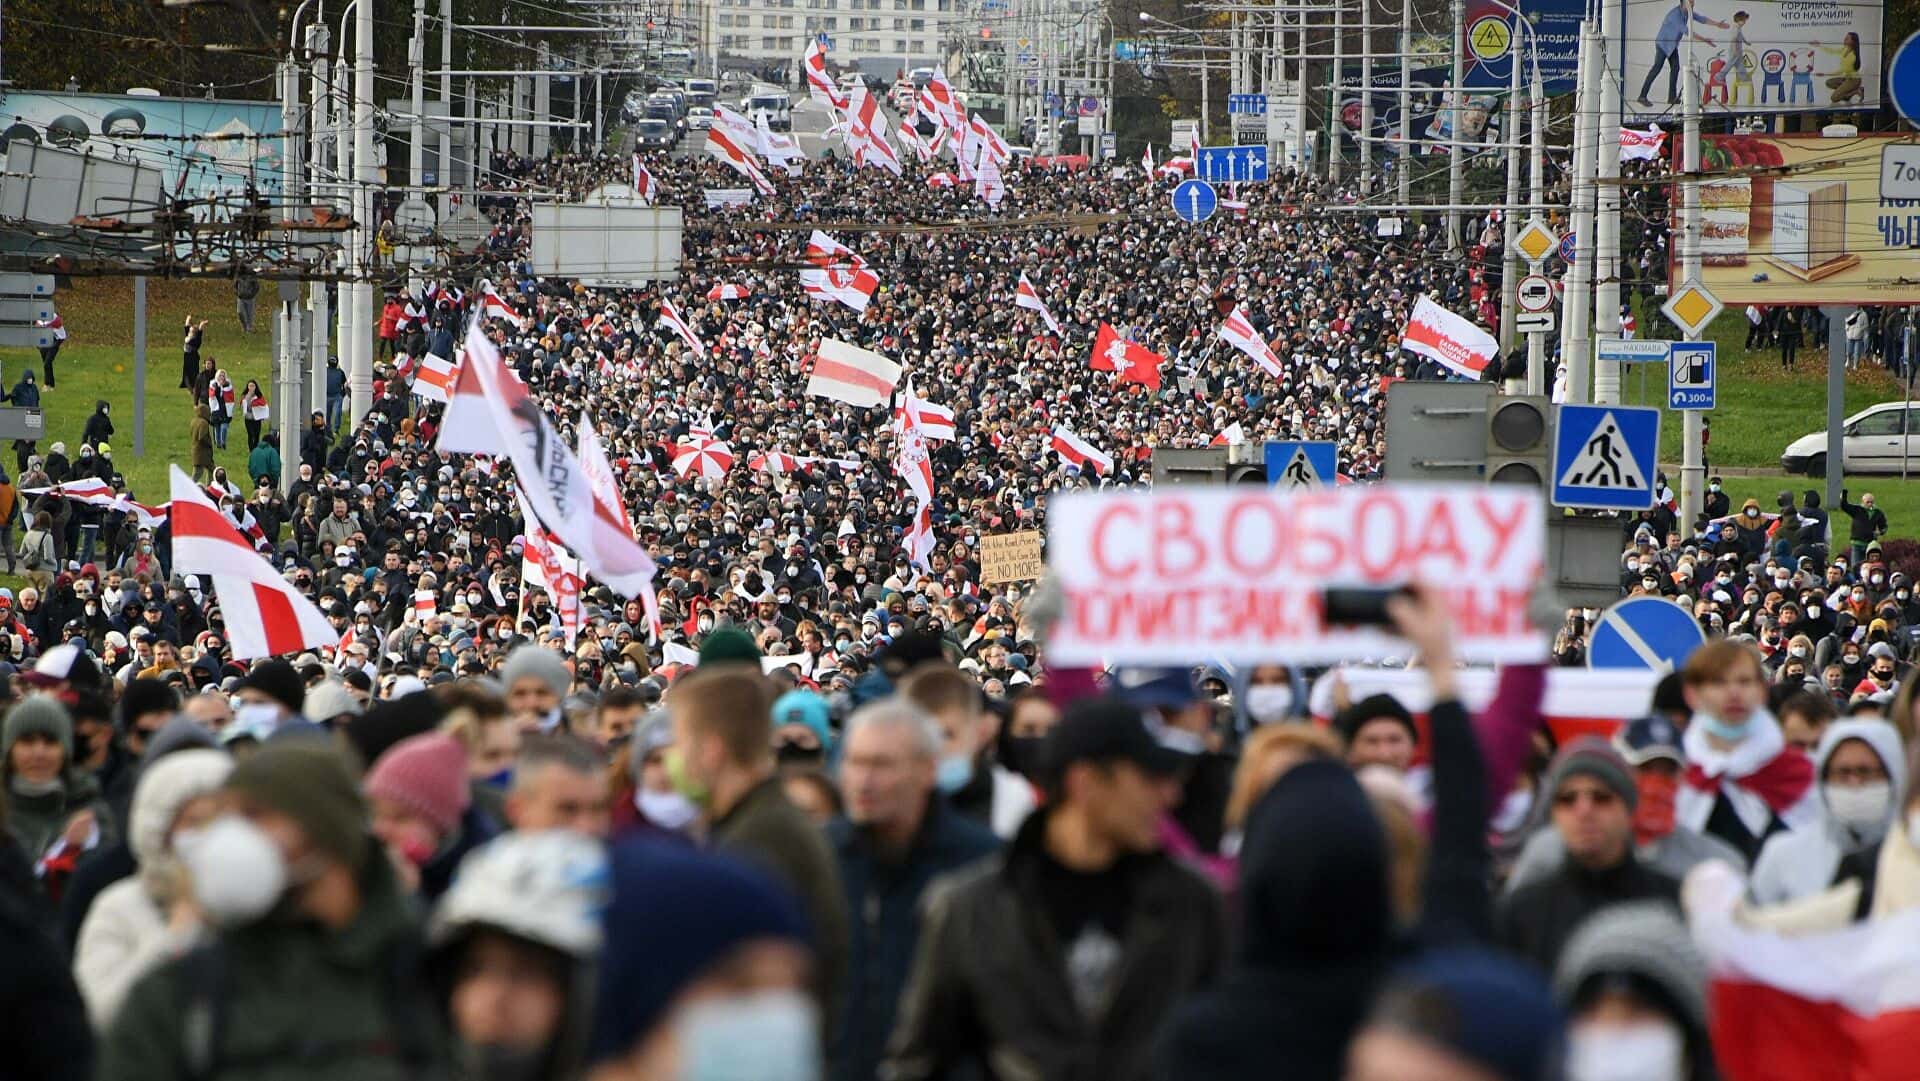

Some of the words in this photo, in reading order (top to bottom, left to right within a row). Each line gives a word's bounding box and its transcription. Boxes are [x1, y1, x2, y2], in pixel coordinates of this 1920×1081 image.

[1781, 11, 1801, 20] ЧТО
[1687, 393, 1706, 404] 300
[1089, 487, 1525, 583] СВОБОДУ
[998, 563, 1010, 578] NO
[1014, 560, 1040, 577] MORE
